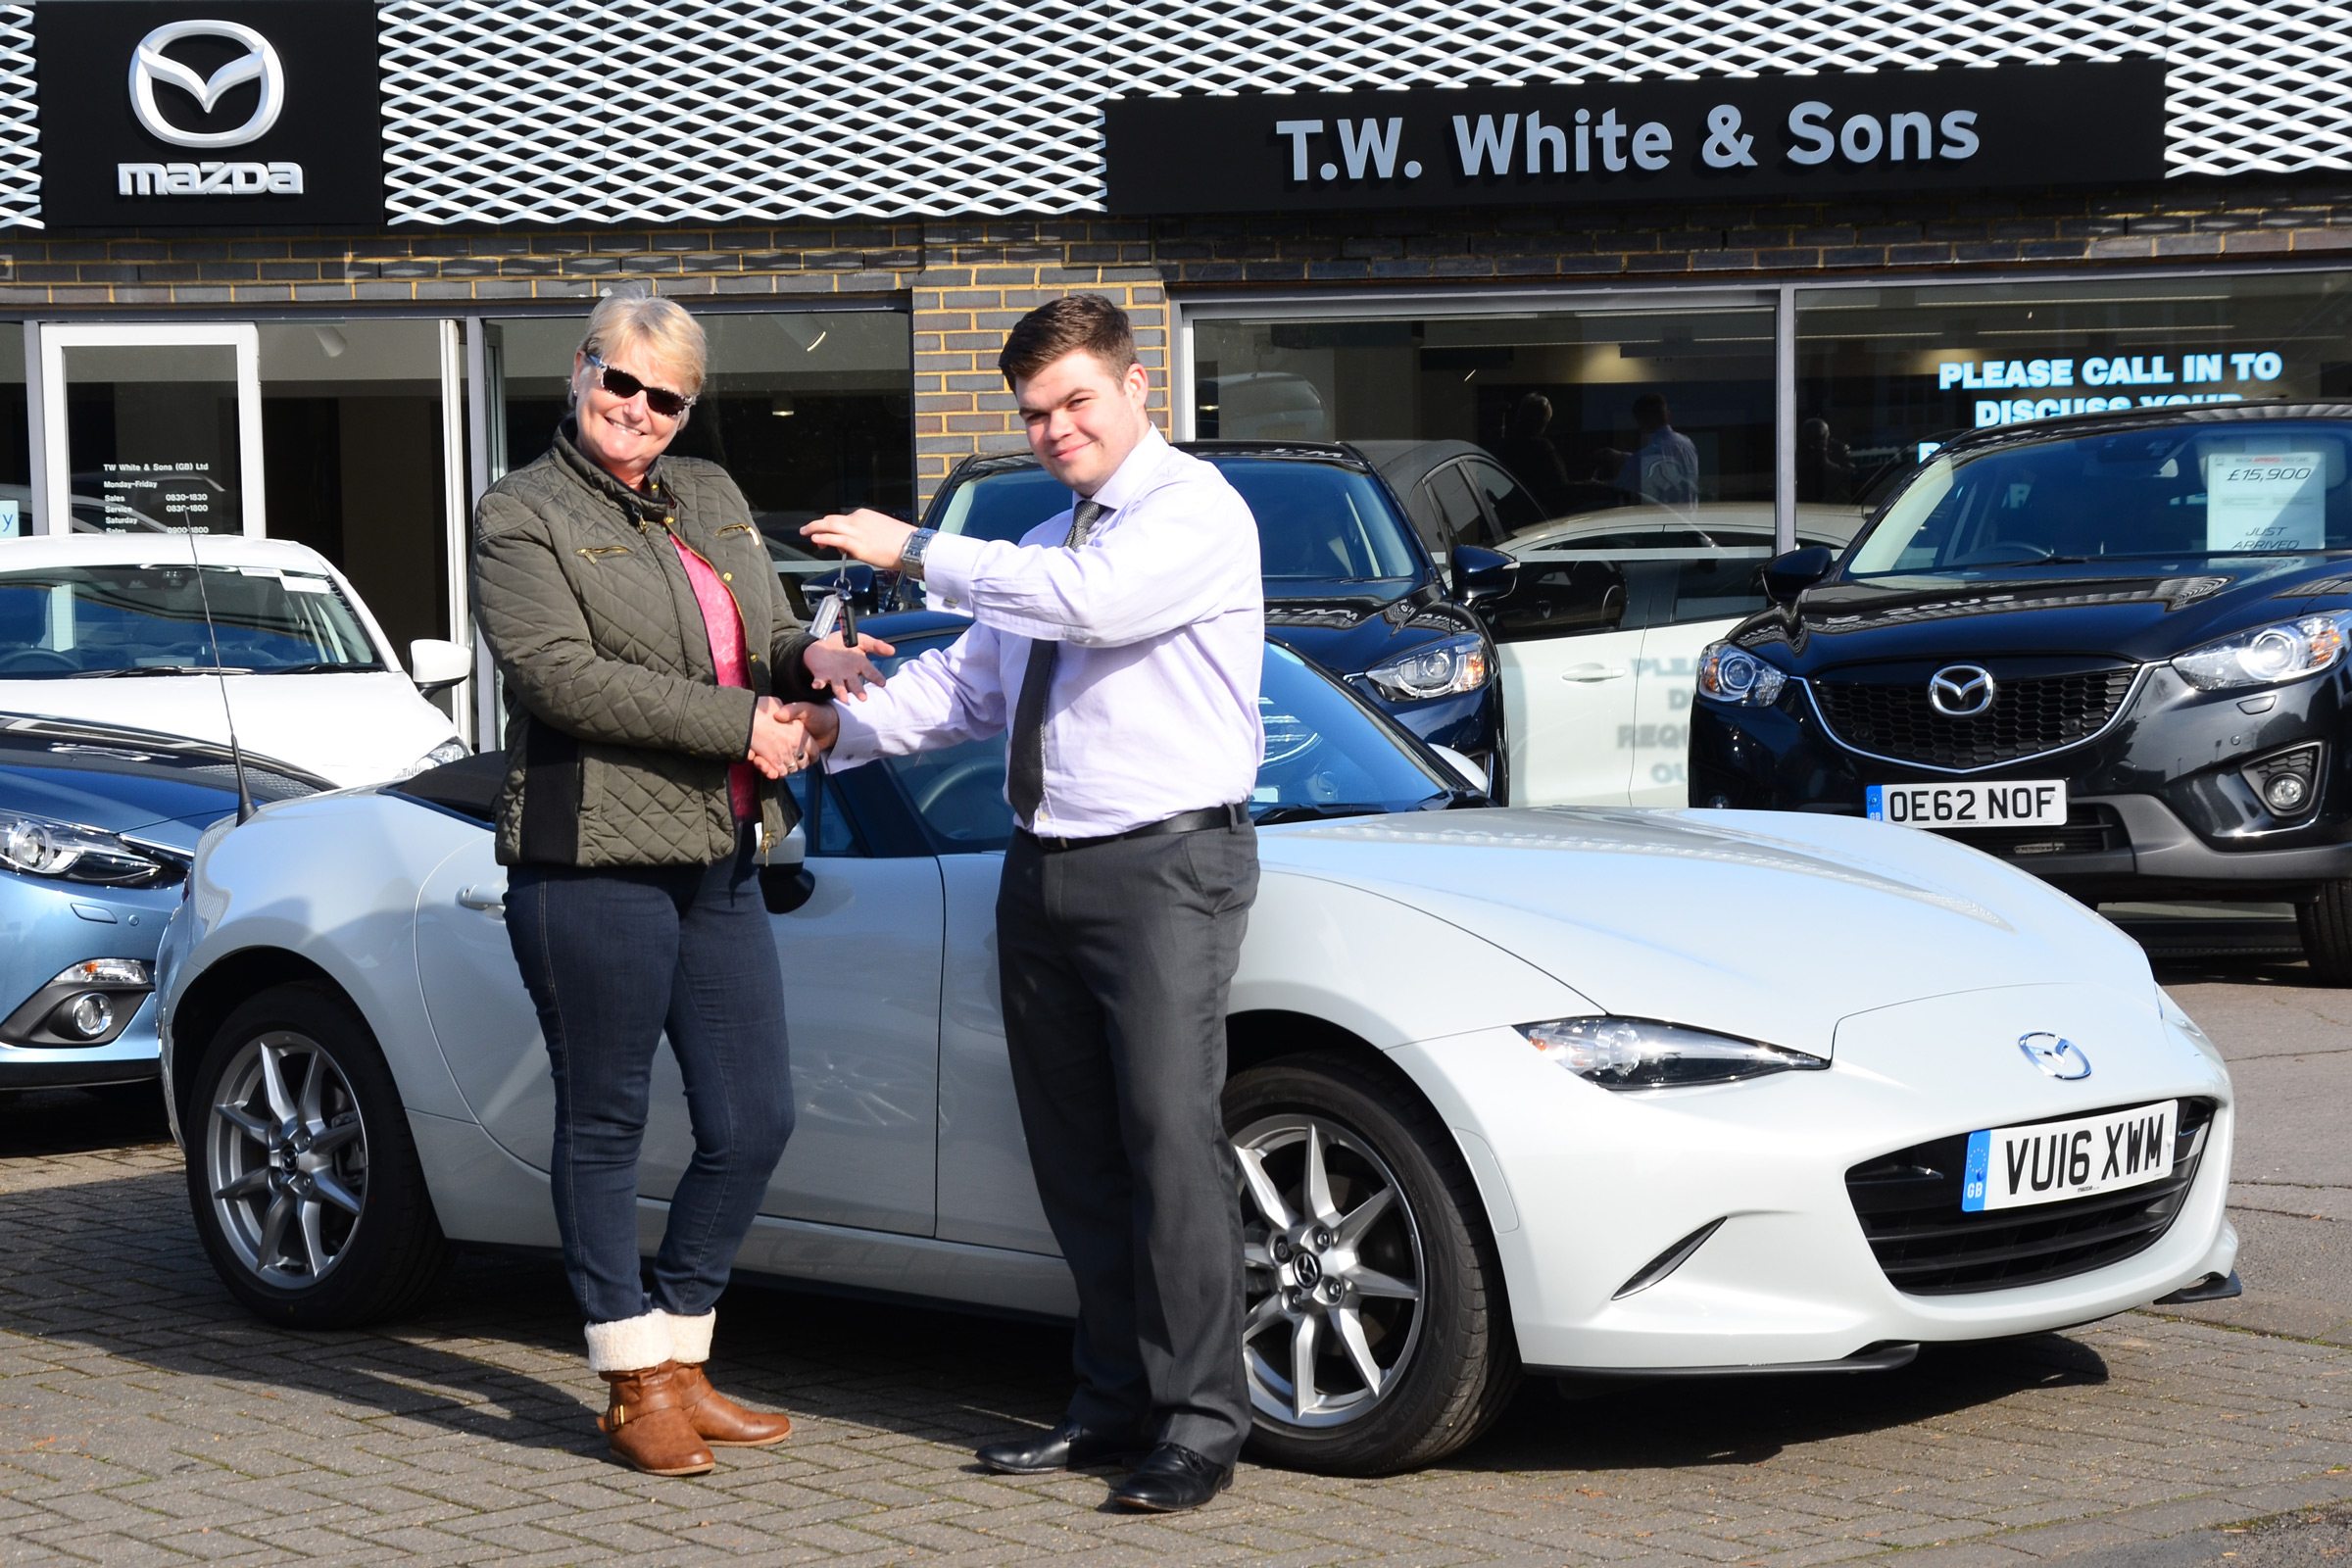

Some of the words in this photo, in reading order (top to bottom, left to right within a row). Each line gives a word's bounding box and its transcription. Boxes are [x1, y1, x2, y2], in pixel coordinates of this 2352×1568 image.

[1276, 118, 1422, 181] T.W.
[1452, 107, 1672, 175] White
[1701, 104, 1758, 169] &
[1787, 101, 1980, 166] Sons
[118, 162, 304, 195] mazda
[1938, 359, 2074, 390] PLEASE
[2082, 356, 2175, 386] CALL
[2182, 354, 2223, 383] IN
[2230, 351, 2282, 381] TO
[2227, 467, 2312, 482] £15,900
[2231, 540, 2300, 549] ARRIVED
[2245, 527, 2288, 536] JUST
[1889, 789, 1976, 821] OE62
[1987, 787, 2056, 819] NOF
[2006, 1130, 2092, 1195] VU16
[2101, 1113, 2165, 1180] XWM
[1967, 1182, 1983, 1199] GB
